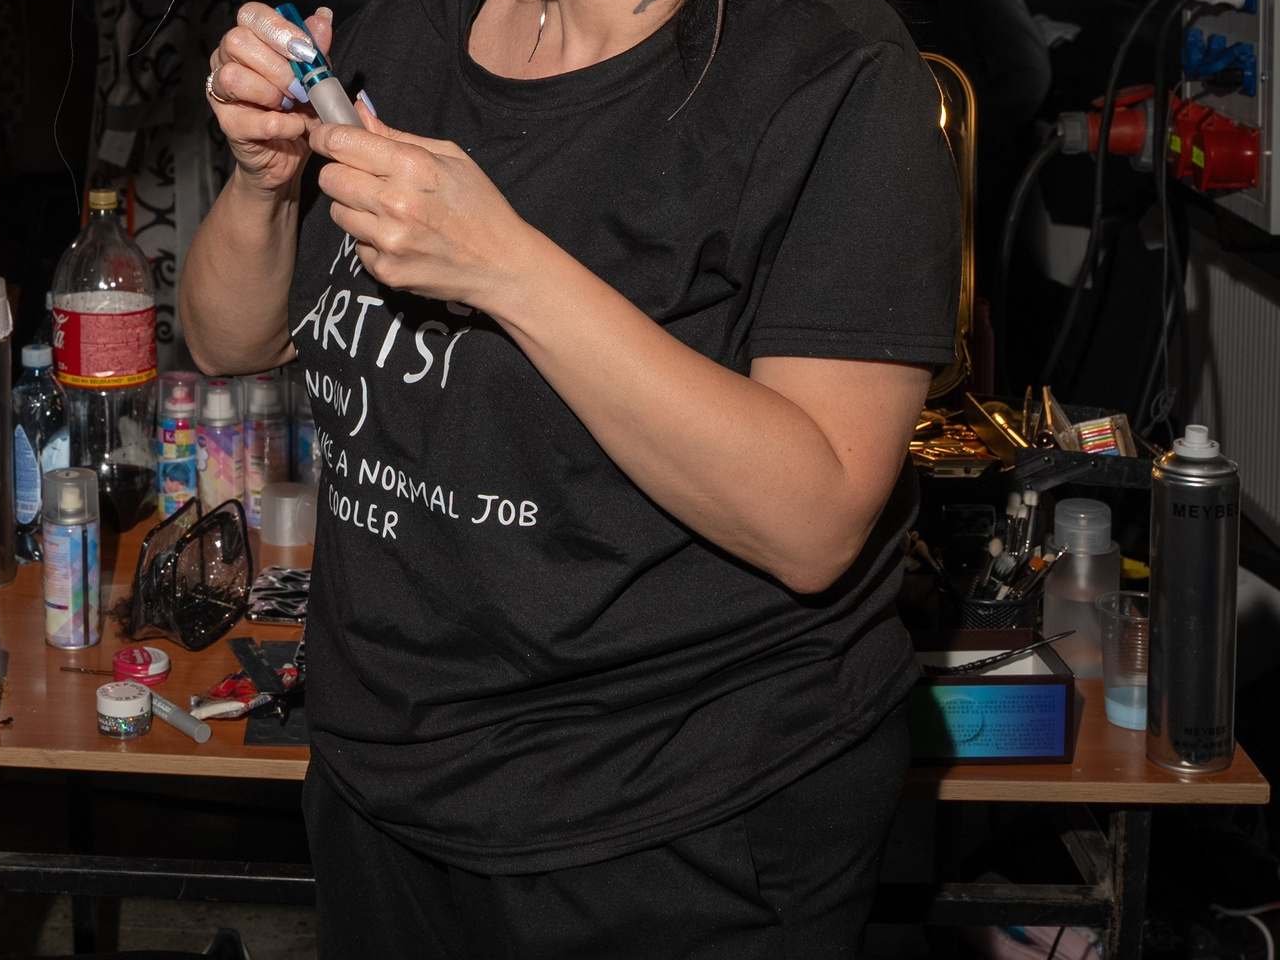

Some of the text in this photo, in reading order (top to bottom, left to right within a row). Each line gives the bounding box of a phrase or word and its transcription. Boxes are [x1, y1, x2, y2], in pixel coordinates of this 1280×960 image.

[292, 285, 471, 389] ARTIST
[305, 369, 368, 437] NOUN)
[329, 484, 399, 540] COOLER
[336, 450, 348, 478] A
[358, 458, 460, 519] NORMAL
[471, 494, 539, 527] JOB
[1173, 501, 1240, 519] MEYBES
[1184, 725, 1226, 736] MEYBES
